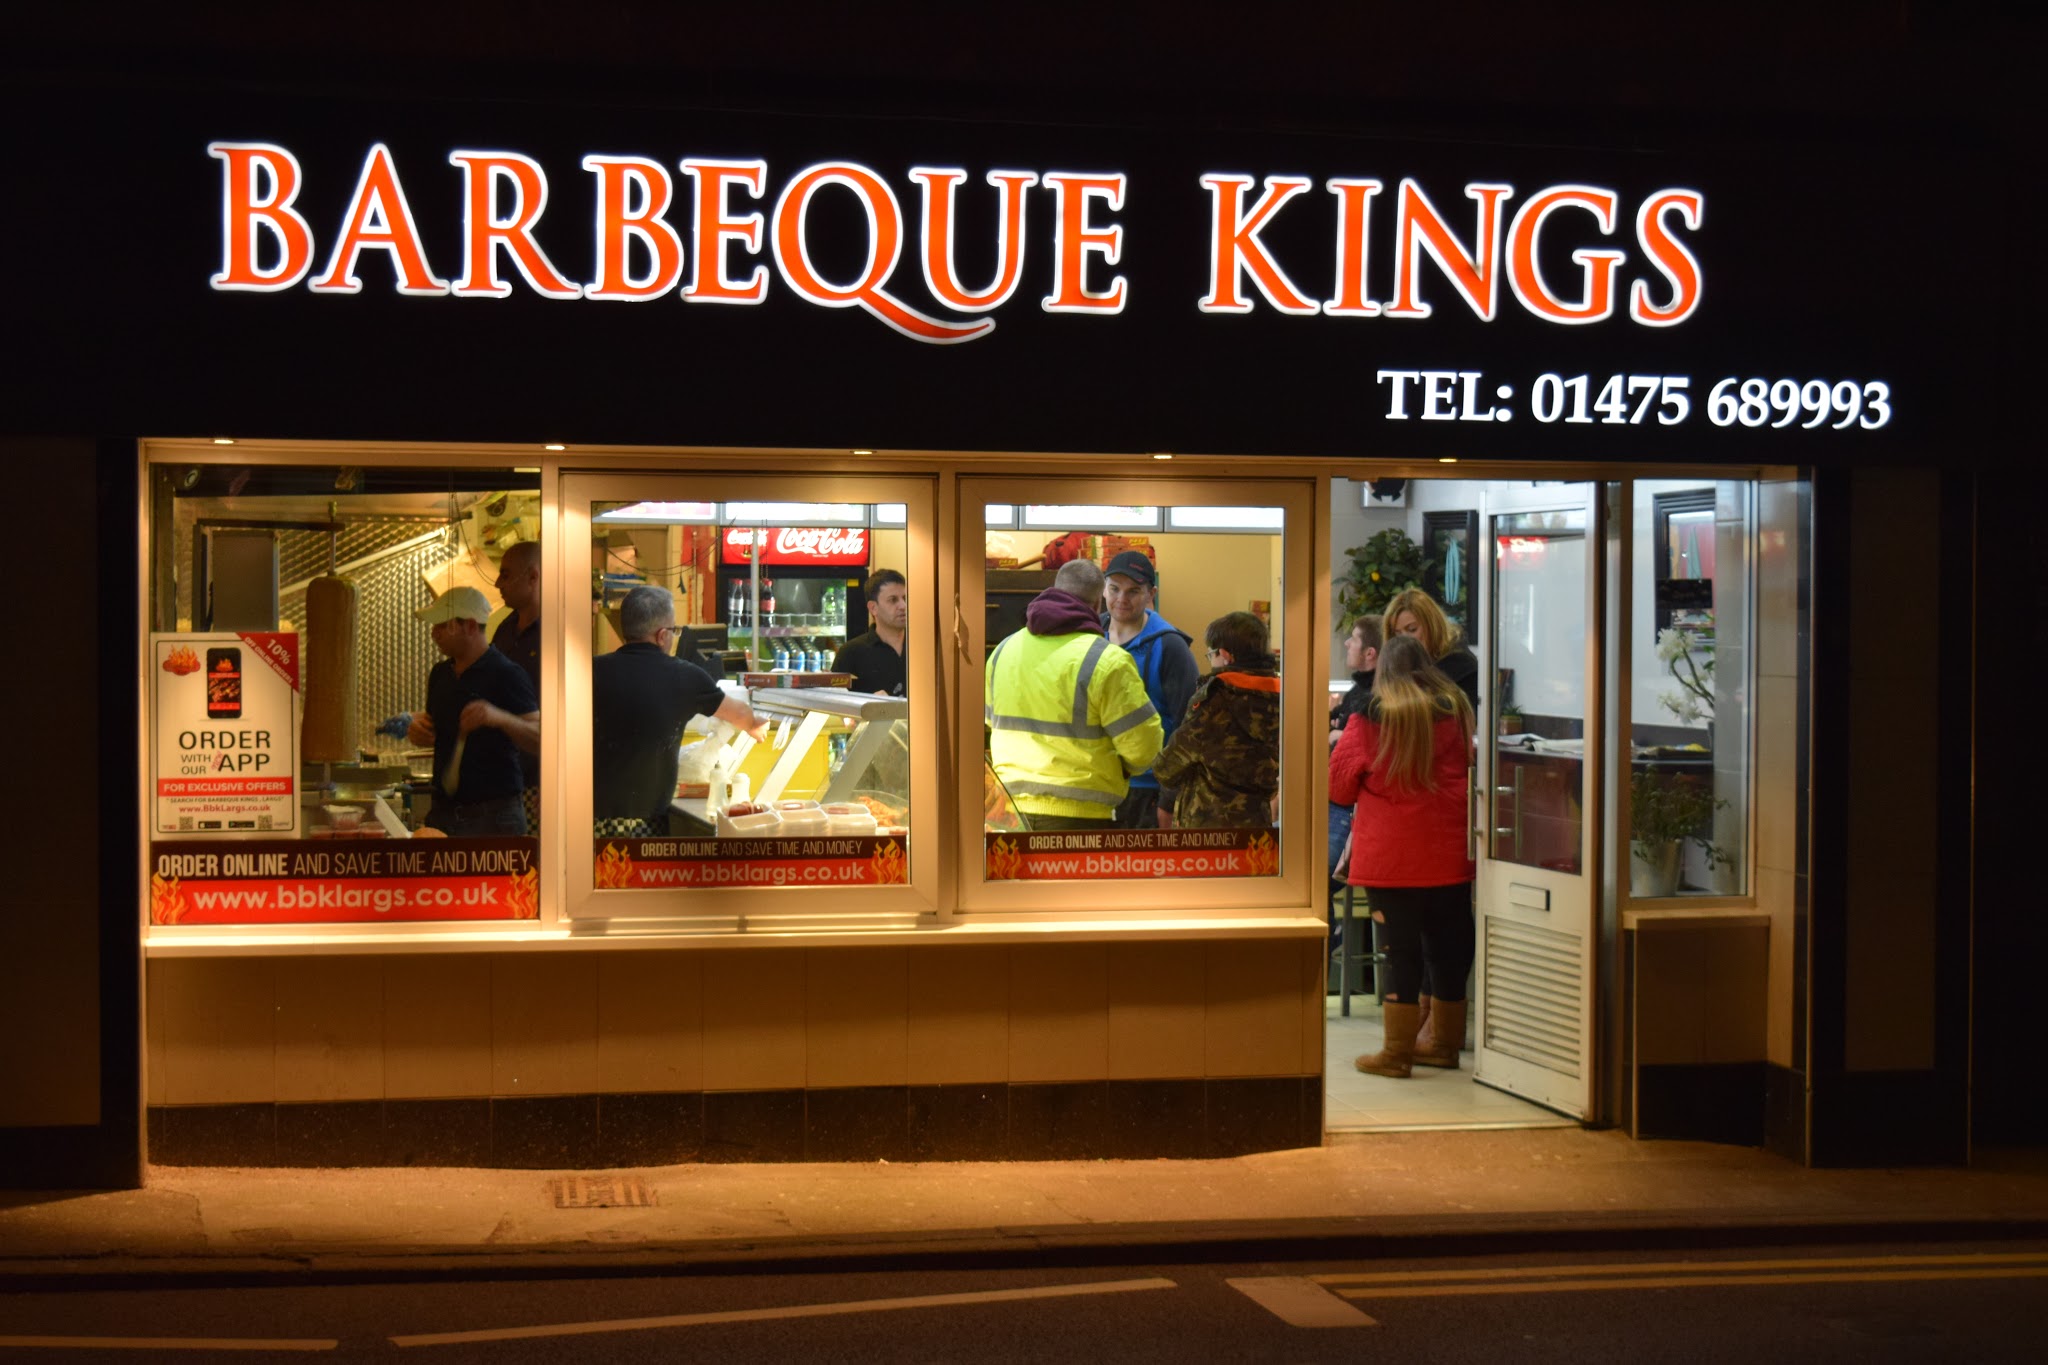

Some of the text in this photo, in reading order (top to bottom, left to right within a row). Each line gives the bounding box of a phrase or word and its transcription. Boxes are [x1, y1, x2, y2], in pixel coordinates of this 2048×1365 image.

[207, 141, 1705, 345] BARBEQUE KINGS
[1377, 369, 1893, 431] TEL: 01475 689993
[244, 637, 293, 683] OFF ONLINE ORDERS
[266, 639, 291, 665] 10%
[179, 730, 271, 750] ORDER
[181, 754, 211, 763] WITH
[181, 765, 207, 775] OUR
[217, 753, 270, 772] APP
[164, 781, 286, 793] FOR EXCLUSIVE OFFERS
[641, 840, 863, 857] ORDER ONLINE AND SAVE TIME AND MONEY
[1029, 832, 1238, 849] ORDER ONLINE AND SAVE TIME AND MONEY
[158, 850, 532, 877] ORDER ONLINE AND SAVE TIME AND MONEY
[639, 862, 865, 885] www.bbklargs.co.uk
[1027, 853, 1240, 876] www.bbklargs.co.uk
[193, 882, 498, 912] www.bbklargs.co.uk
